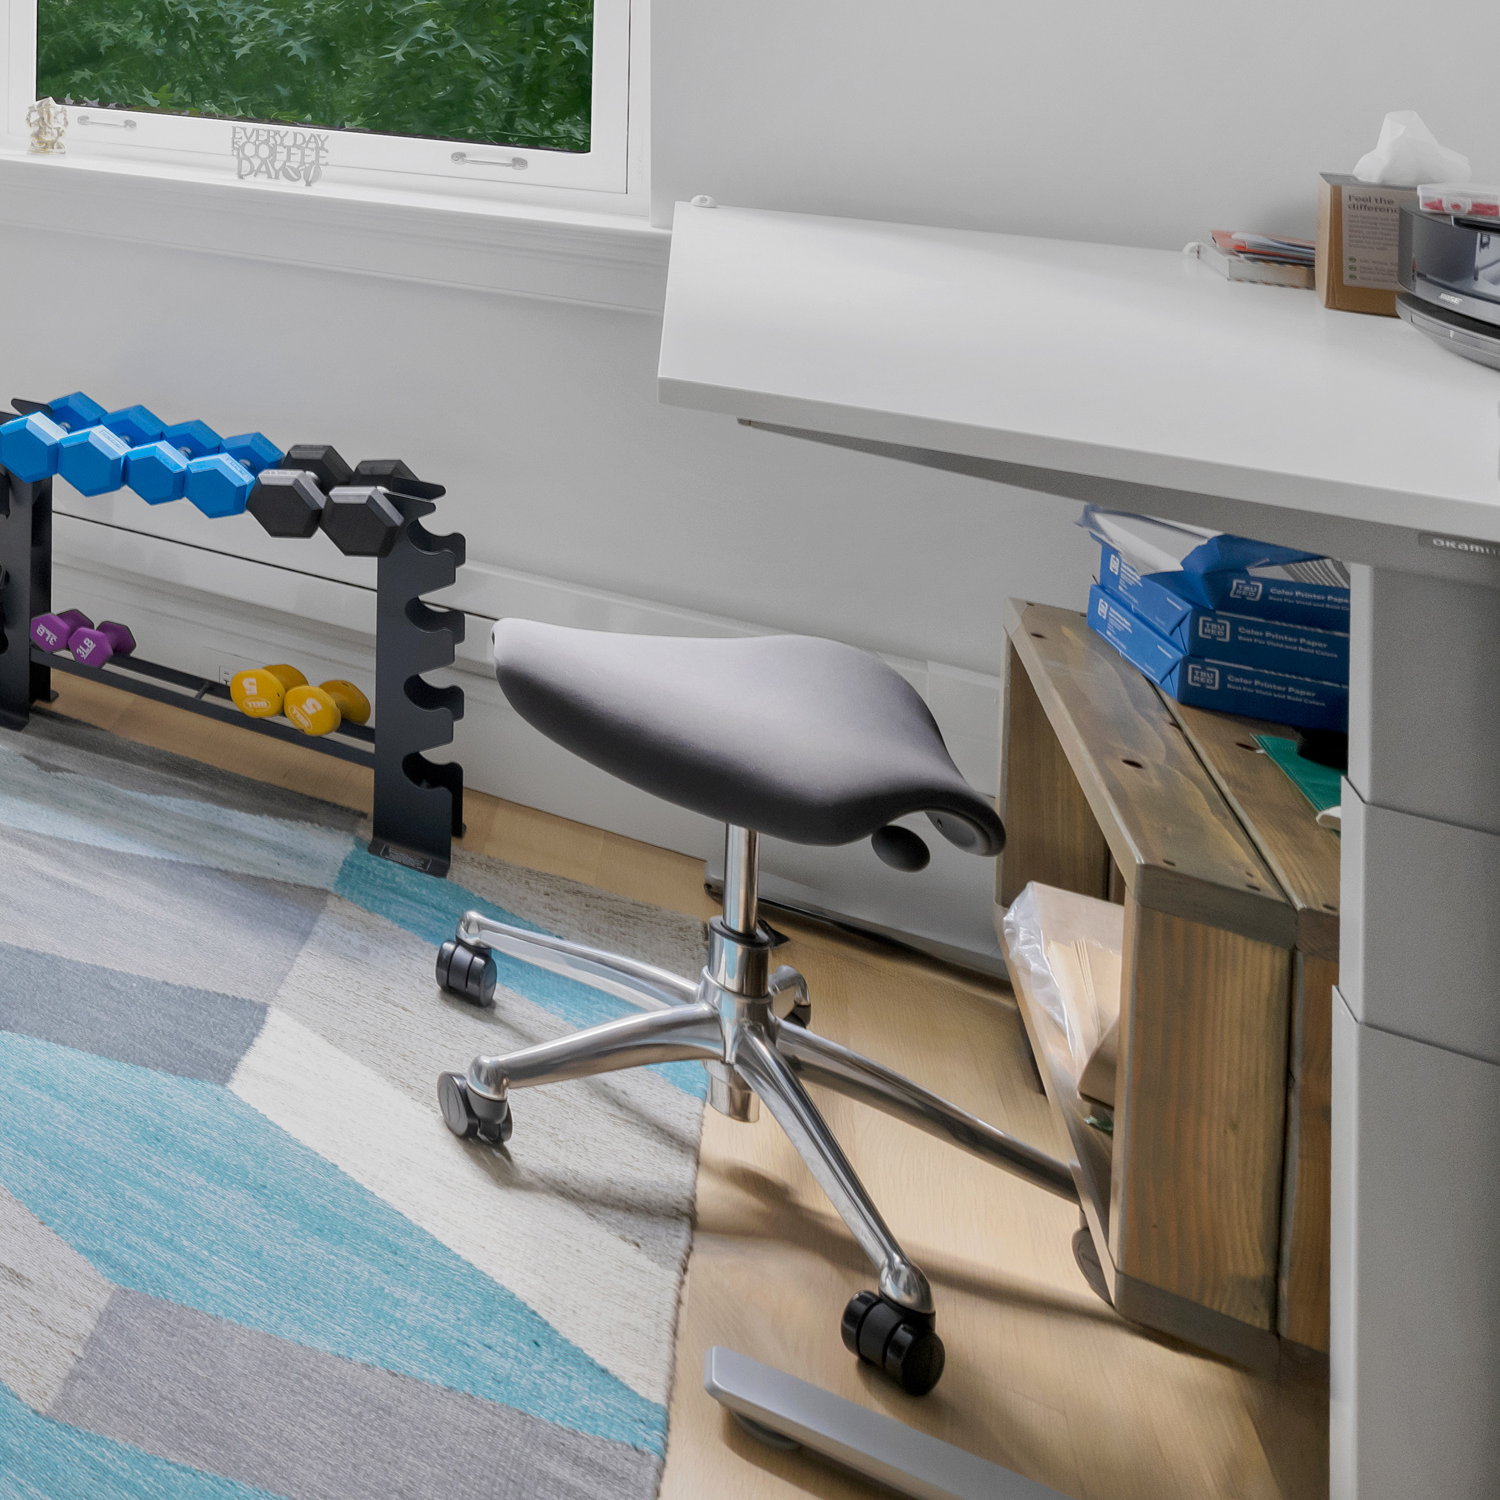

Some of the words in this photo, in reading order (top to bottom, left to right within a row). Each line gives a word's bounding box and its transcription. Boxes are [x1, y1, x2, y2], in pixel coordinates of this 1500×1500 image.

[231, 126, 289, 145] EVERY
[292, 131, 329, 150] DAY
[241, 140, 329, 166] COFFEE
[236, 156, 282, 180] DAY
[1349, 194, 1371, 202] Feel
[1375, 196, 1394, 205] the
[36, 624, 58, 645] 3LB
[1238, 626, 1265, 636] Color
[1266, 631, 1298, 644] Printer
[1300, 637, 1328, 649] Paper
[76, 637, 96, 659] 3LB
[242, 678, 257, 696] 5
[302, 697, 323, 716] 5
